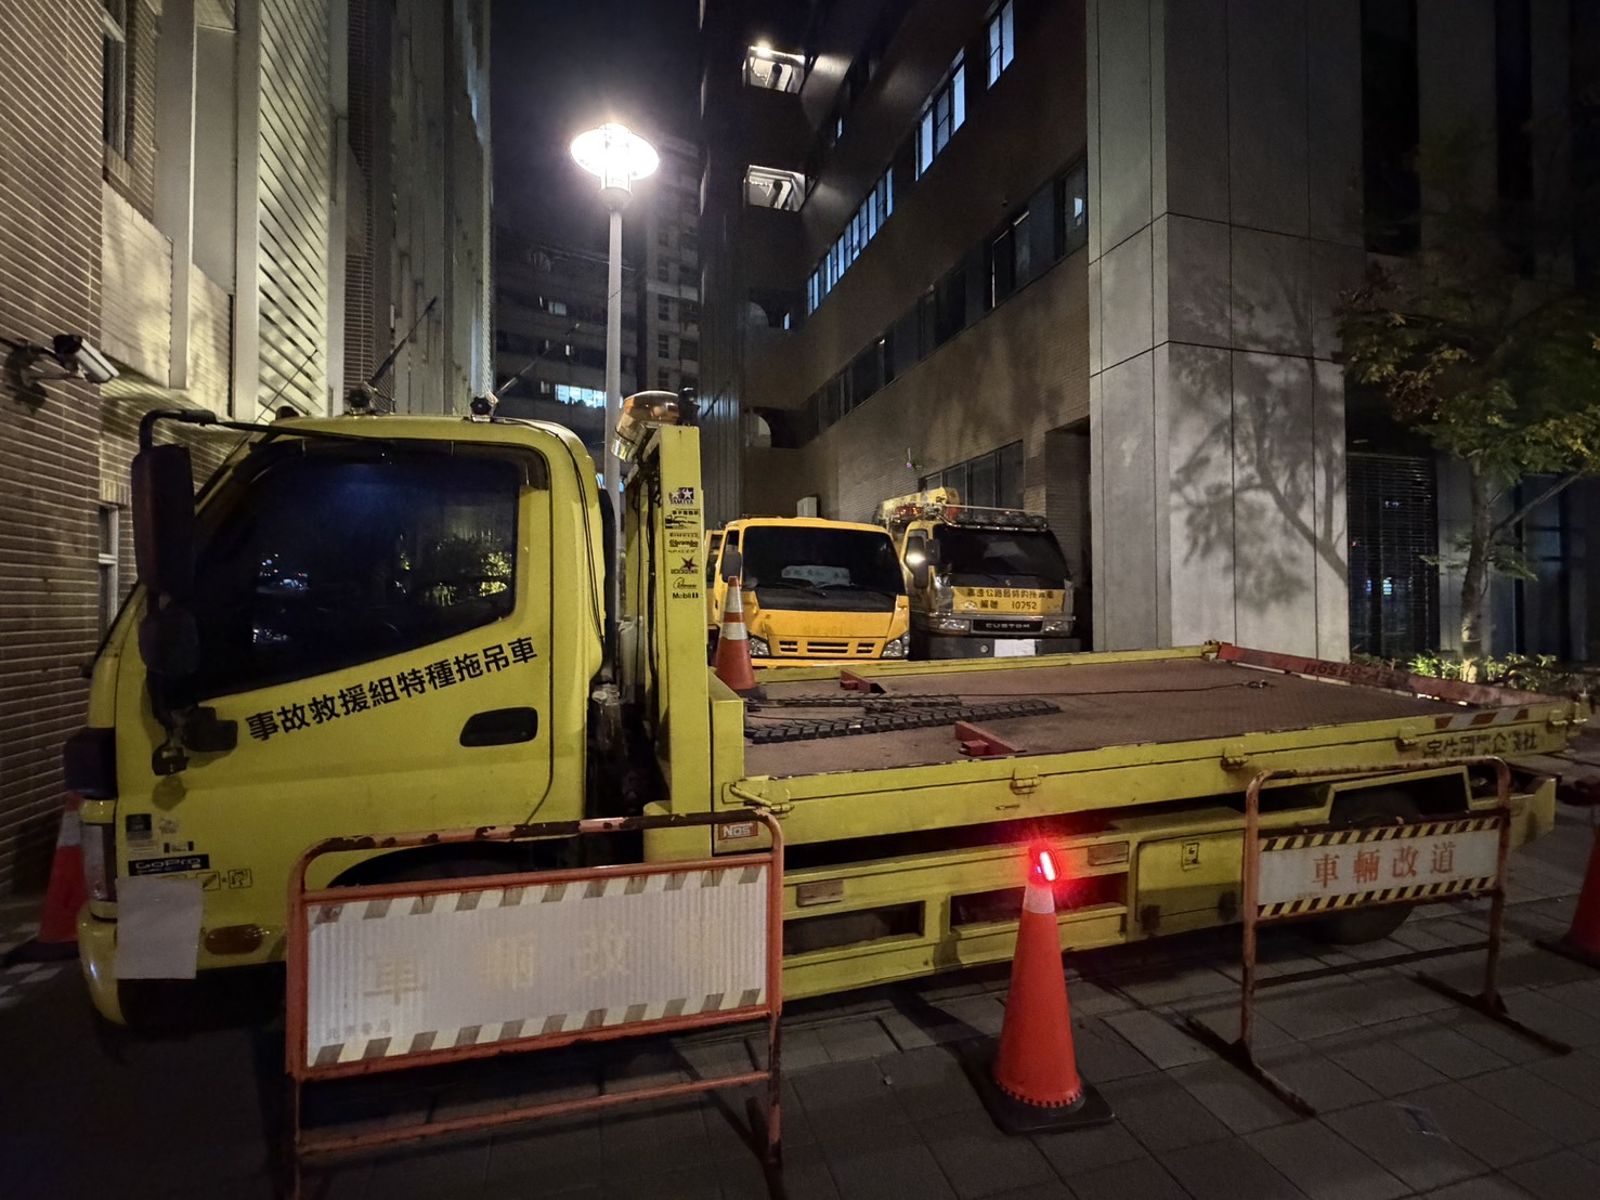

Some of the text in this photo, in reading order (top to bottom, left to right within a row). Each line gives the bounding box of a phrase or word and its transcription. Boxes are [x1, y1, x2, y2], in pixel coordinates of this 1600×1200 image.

[1011, 600, 1038, 610] 10752
[245, 636, 538, 742] 事故救援組特種拖吊車
[135, 857, 202, 870] GoPro
[1312, 842, 1458, 889] 車輛改道
